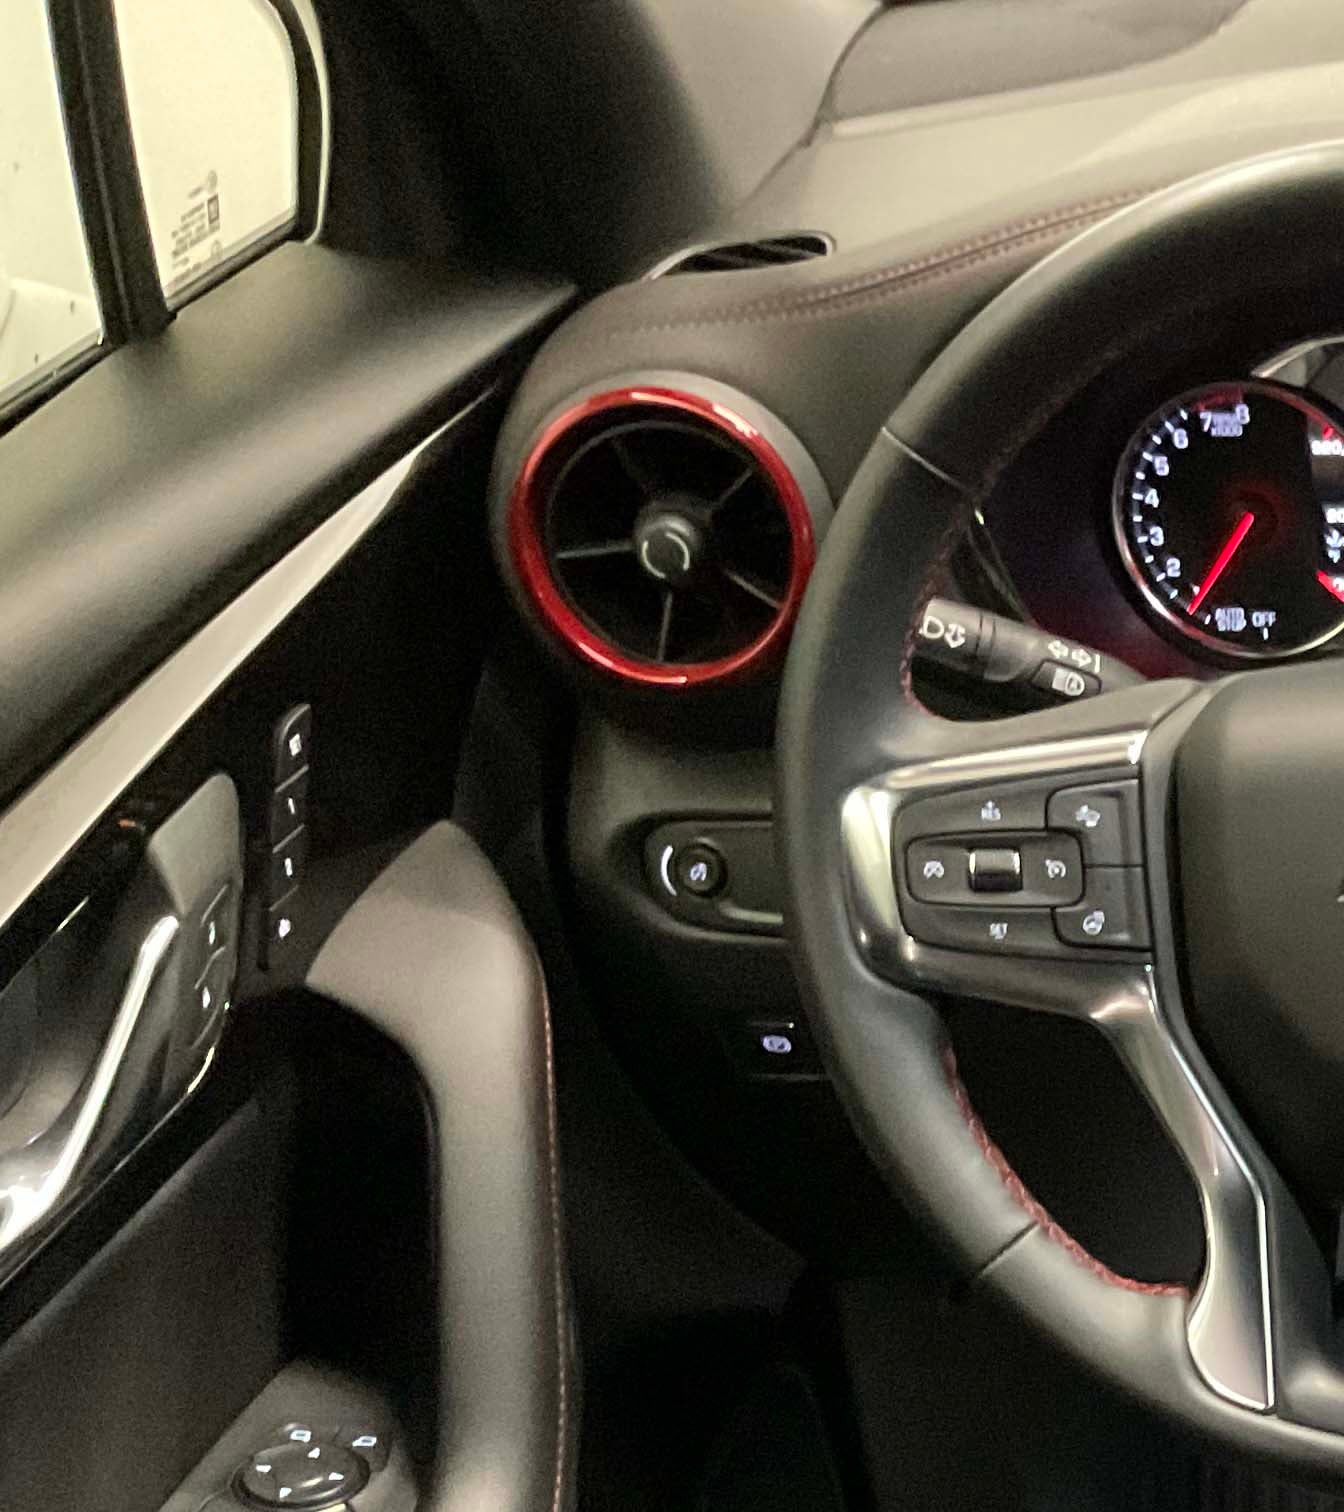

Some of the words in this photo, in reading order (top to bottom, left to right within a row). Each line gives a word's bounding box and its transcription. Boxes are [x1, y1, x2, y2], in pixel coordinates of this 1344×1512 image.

[1199, 411, 1212, 432] 7
[1144, 488, 1159, 508] 4
[1150, 527, 1164, 547] 3
[1166, 558, 1181, 578] 2
[1252, 611, 1277, 627] OFF
